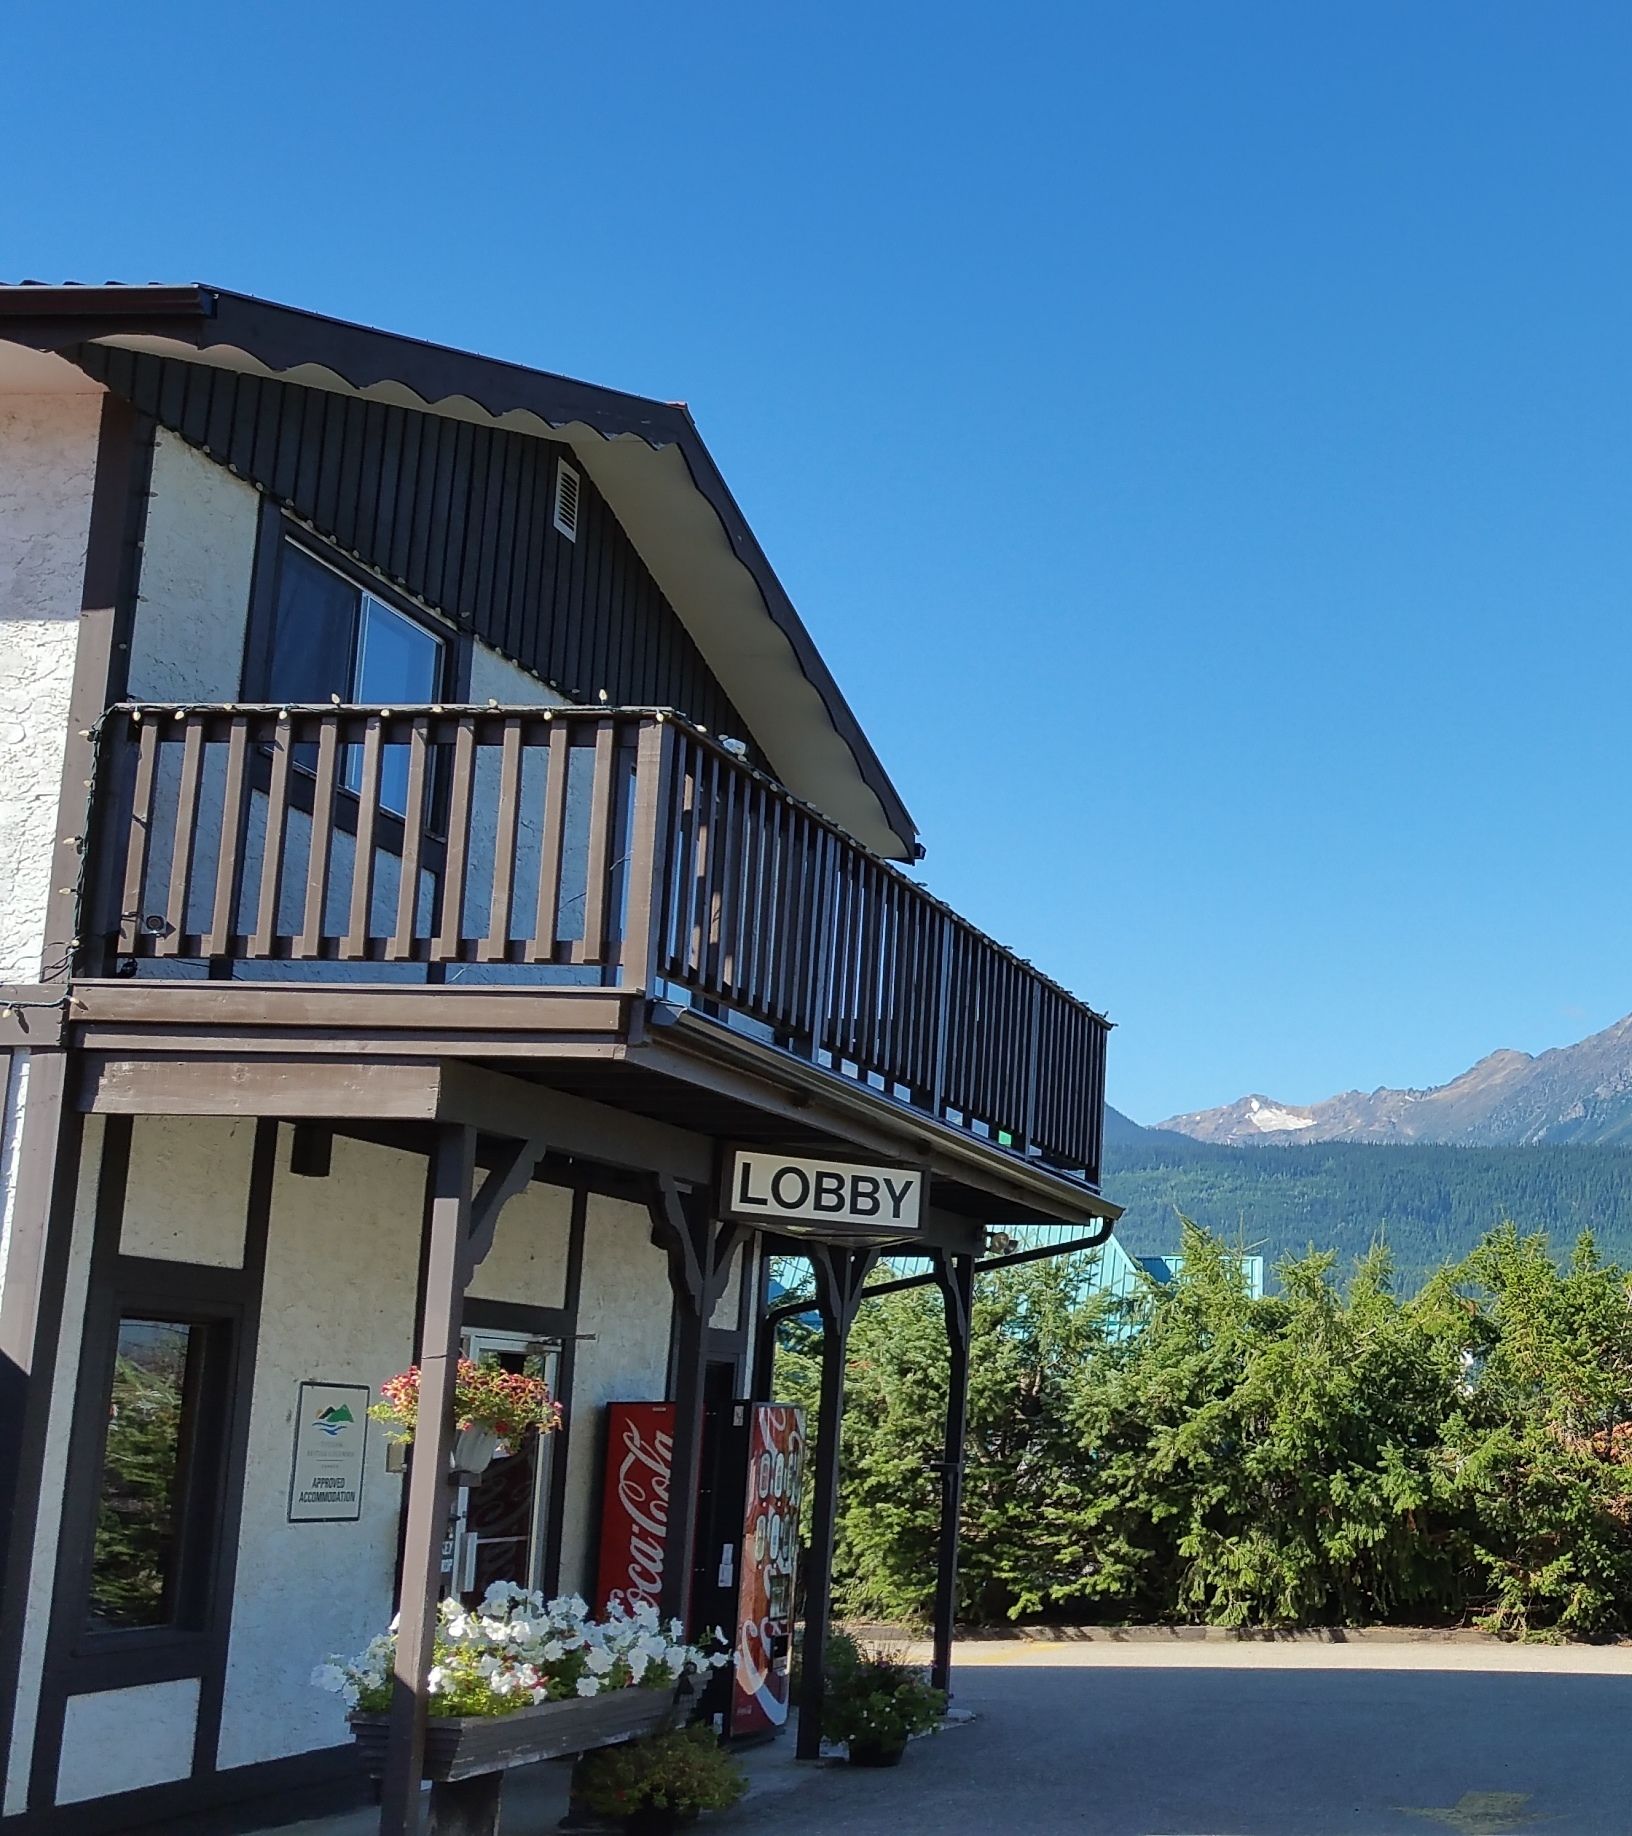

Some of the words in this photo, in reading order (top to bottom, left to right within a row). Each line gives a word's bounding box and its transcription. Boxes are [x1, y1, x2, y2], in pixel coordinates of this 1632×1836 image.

[739, 1161, 915, 1219] LOBBY
[312, 1477, 345, 1489] APPROVED
[299, 1491, 355, 1502] ACCOMMODATION
